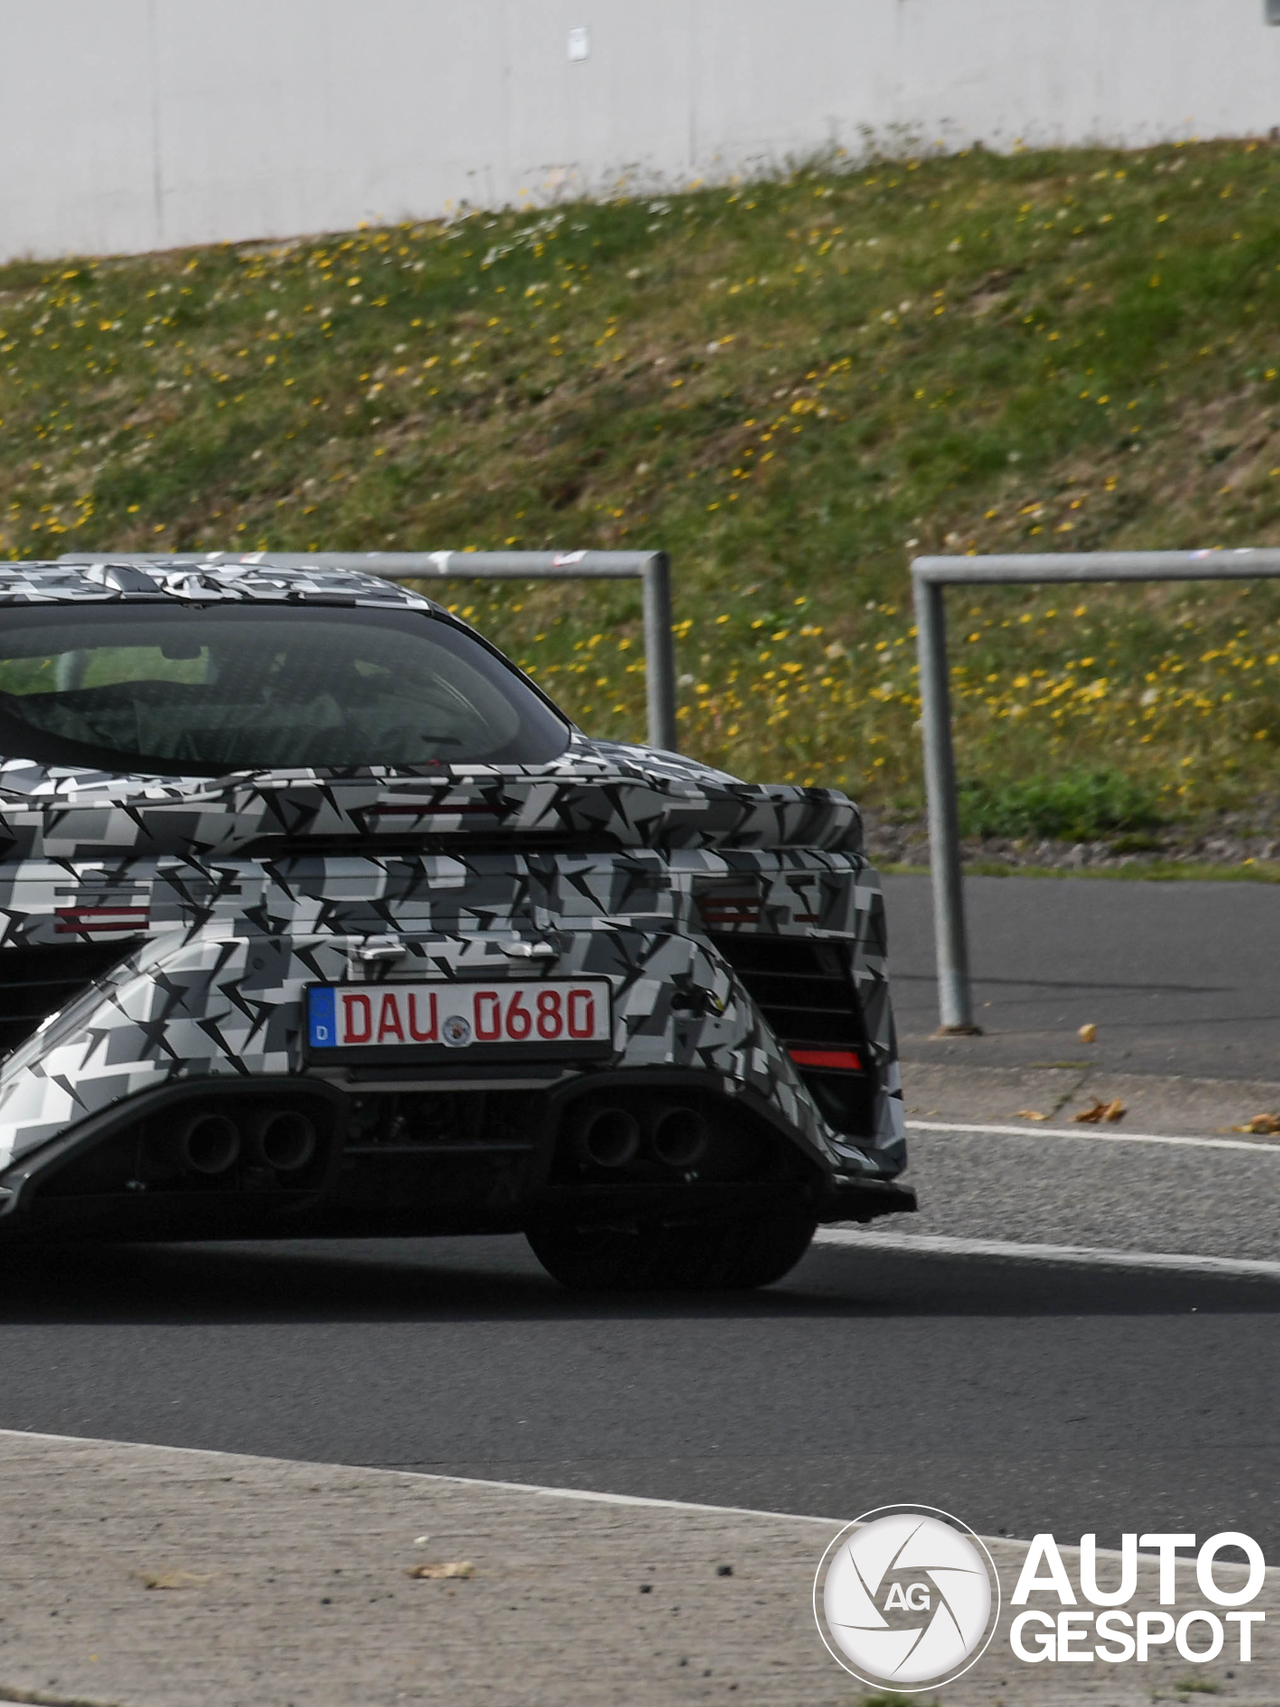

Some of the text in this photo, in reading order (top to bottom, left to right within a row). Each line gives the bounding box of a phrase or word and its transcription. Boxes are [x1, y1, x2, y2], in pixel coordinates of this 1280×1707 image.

[316, 1025, 328, 1041] D
[342, 989, 594, 1043] DAU 0680
